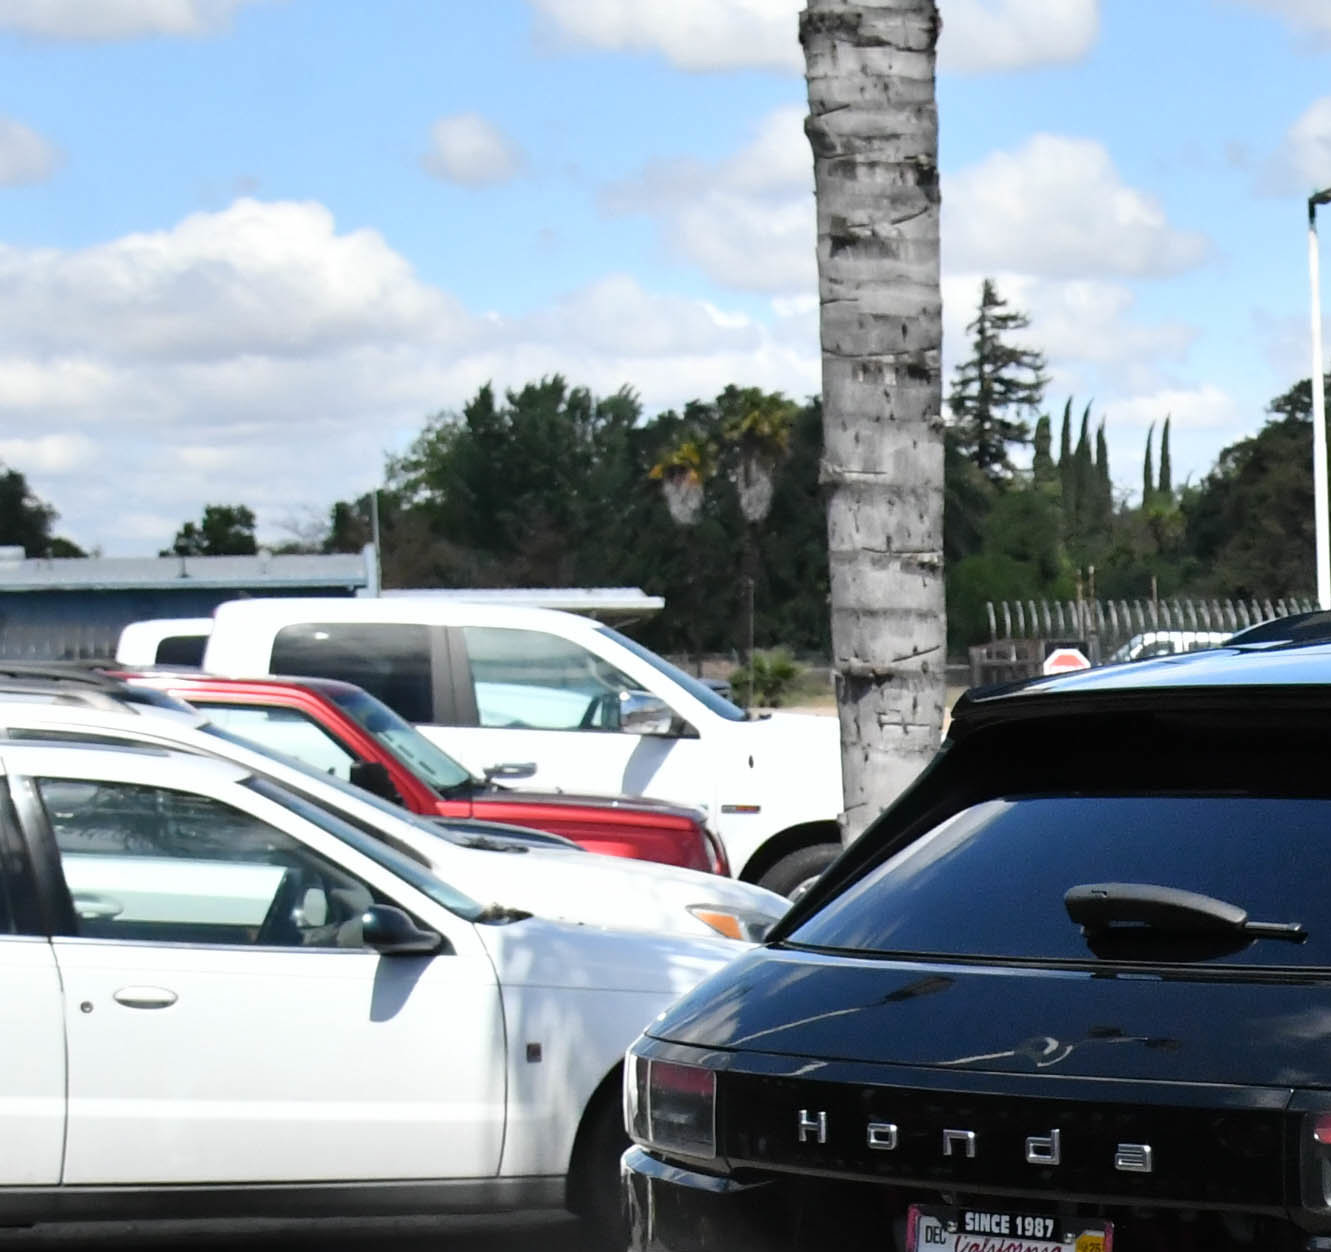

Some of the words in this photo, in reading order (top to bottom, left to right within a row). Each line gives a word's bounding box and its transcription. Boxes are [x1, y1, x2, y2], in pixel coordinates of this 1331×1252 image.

[798, 1108, 1153, 1173] Honda
[924, 1225, 947, 1245] DEC
[965, 1211, 1010, 1234] SINCE
[1016, 1215, 1055, 1238] 1987
